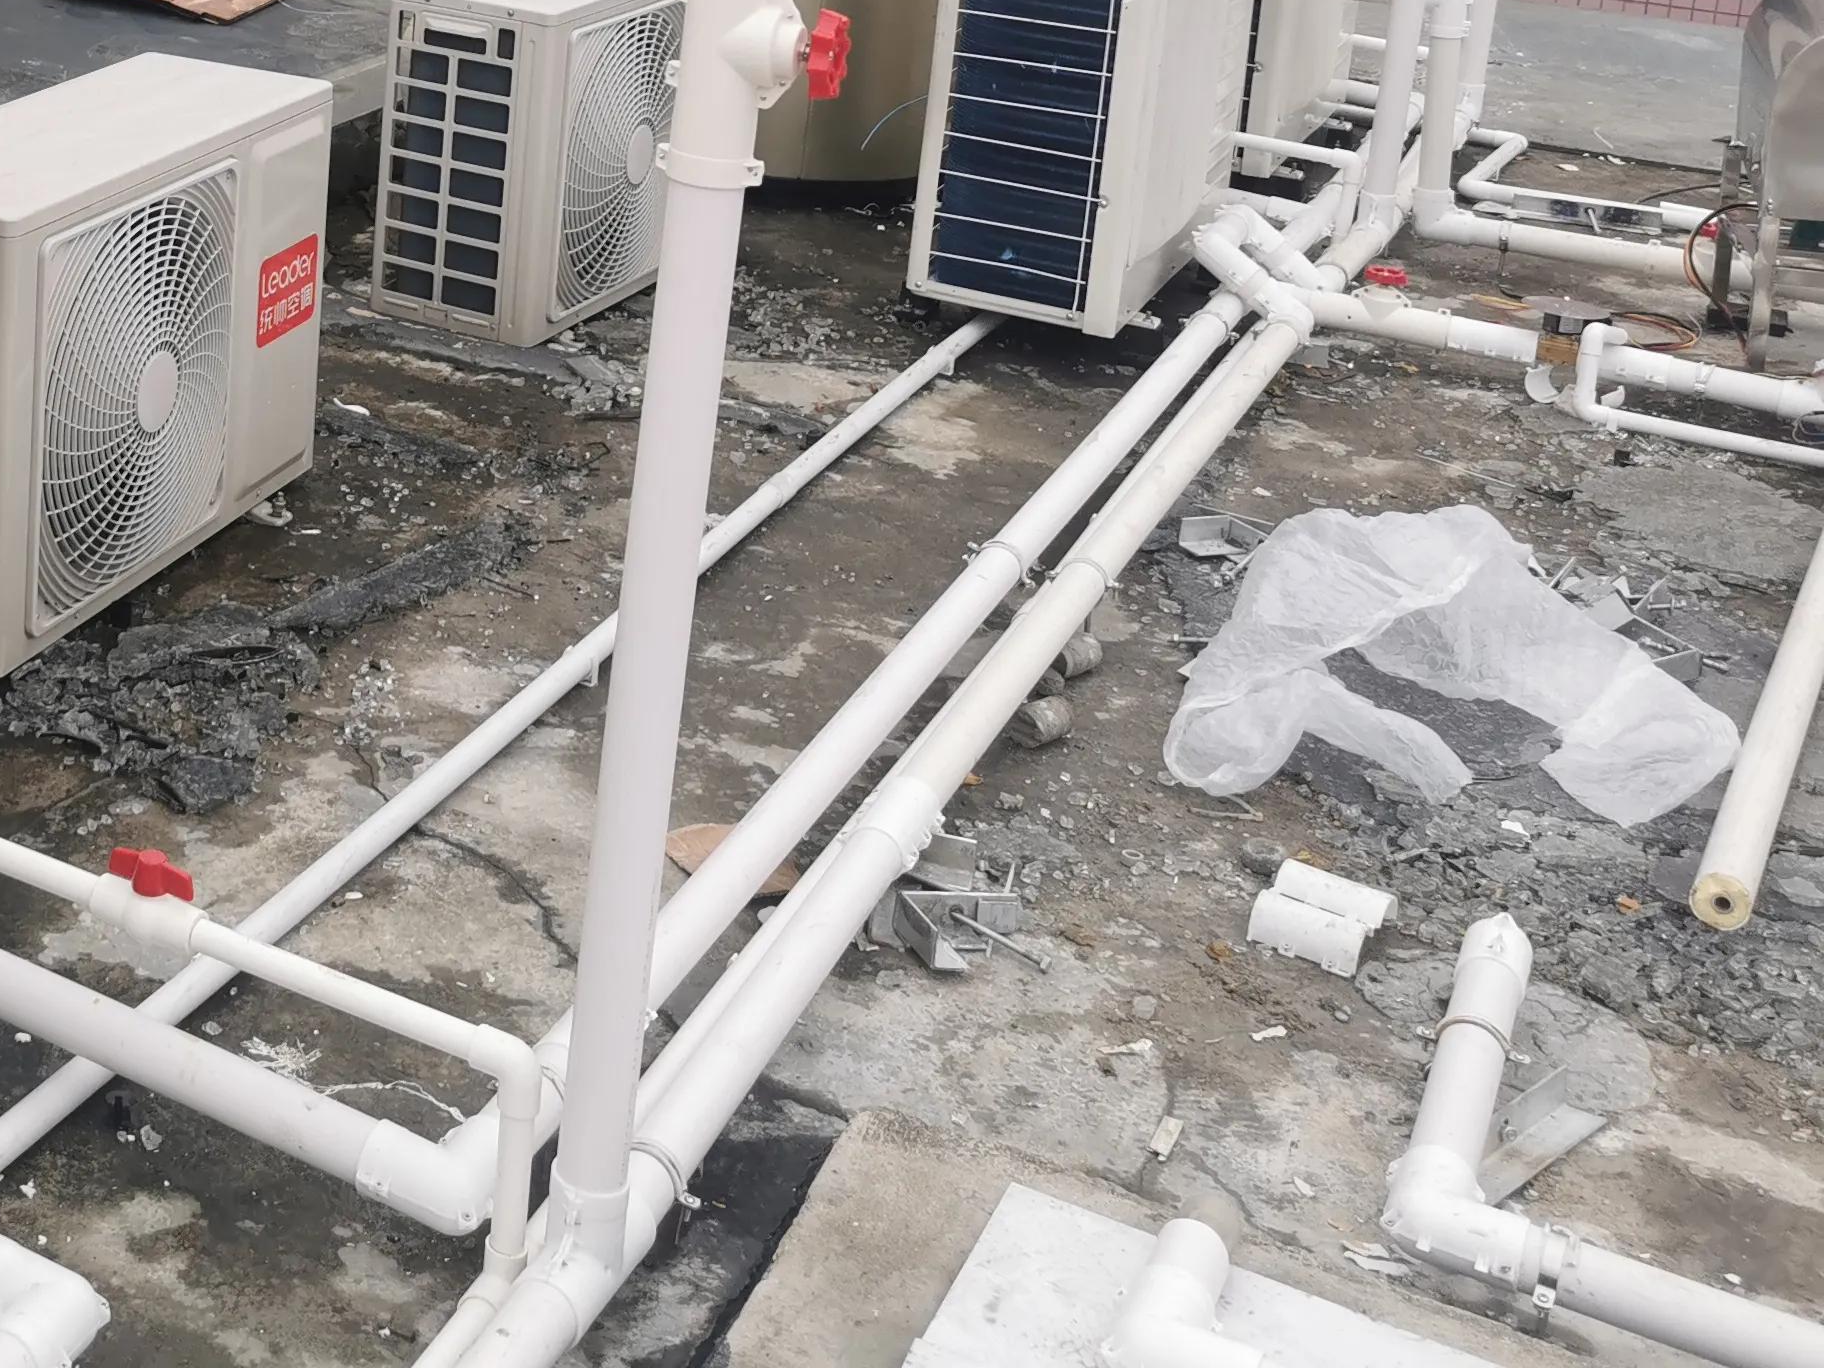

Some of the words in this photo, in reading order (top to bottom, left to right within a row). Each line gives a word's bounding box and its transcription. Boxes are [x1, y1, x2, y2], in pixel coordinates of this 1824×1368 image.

[262, 251, 315, 299] Leader
[259, 282, 314, 336] 统帅空调
